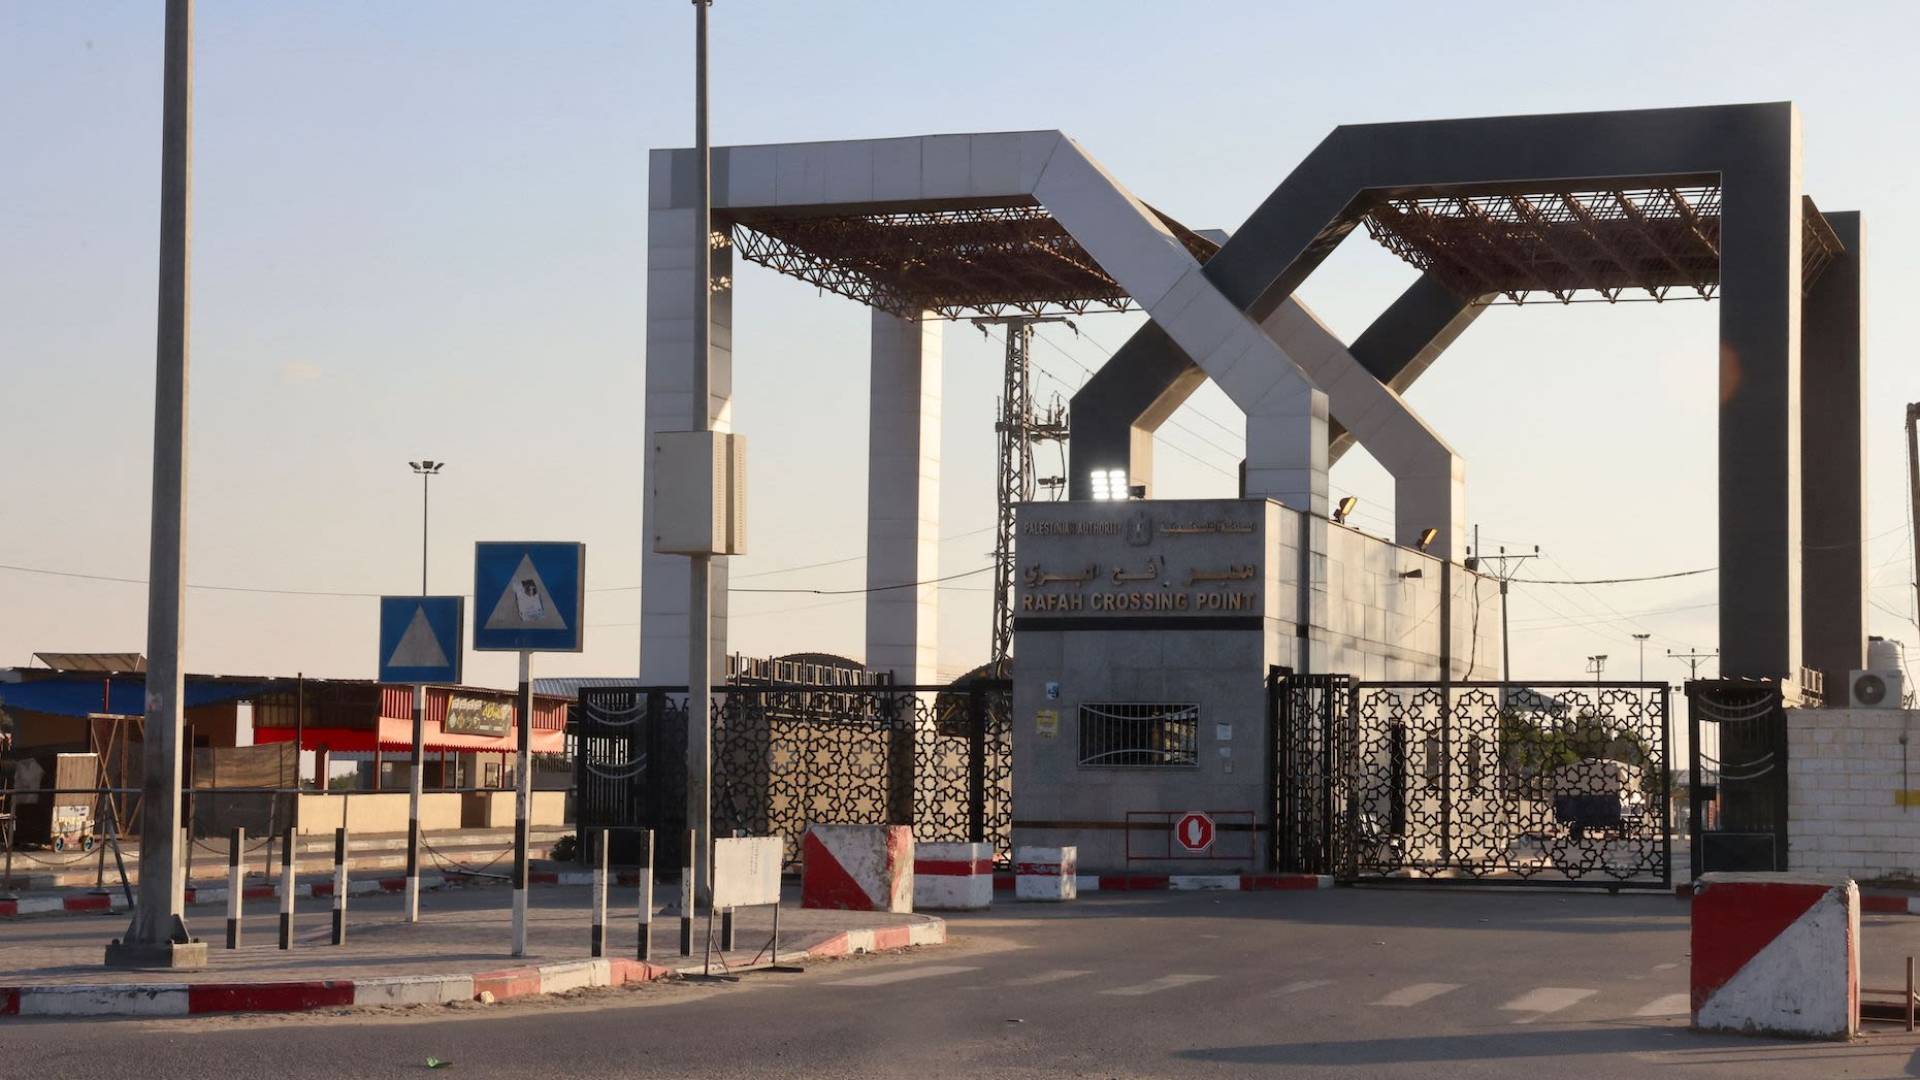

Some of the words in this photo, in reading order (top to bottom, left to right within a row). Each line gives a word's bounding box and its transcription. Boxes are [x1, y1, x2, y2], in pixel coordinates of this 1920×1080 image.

[1022, 592, 1083, 612] RAFAH
[1090, 592, 1189, 612] CROSSING
[1196, 592, 1256, 612] POINT
